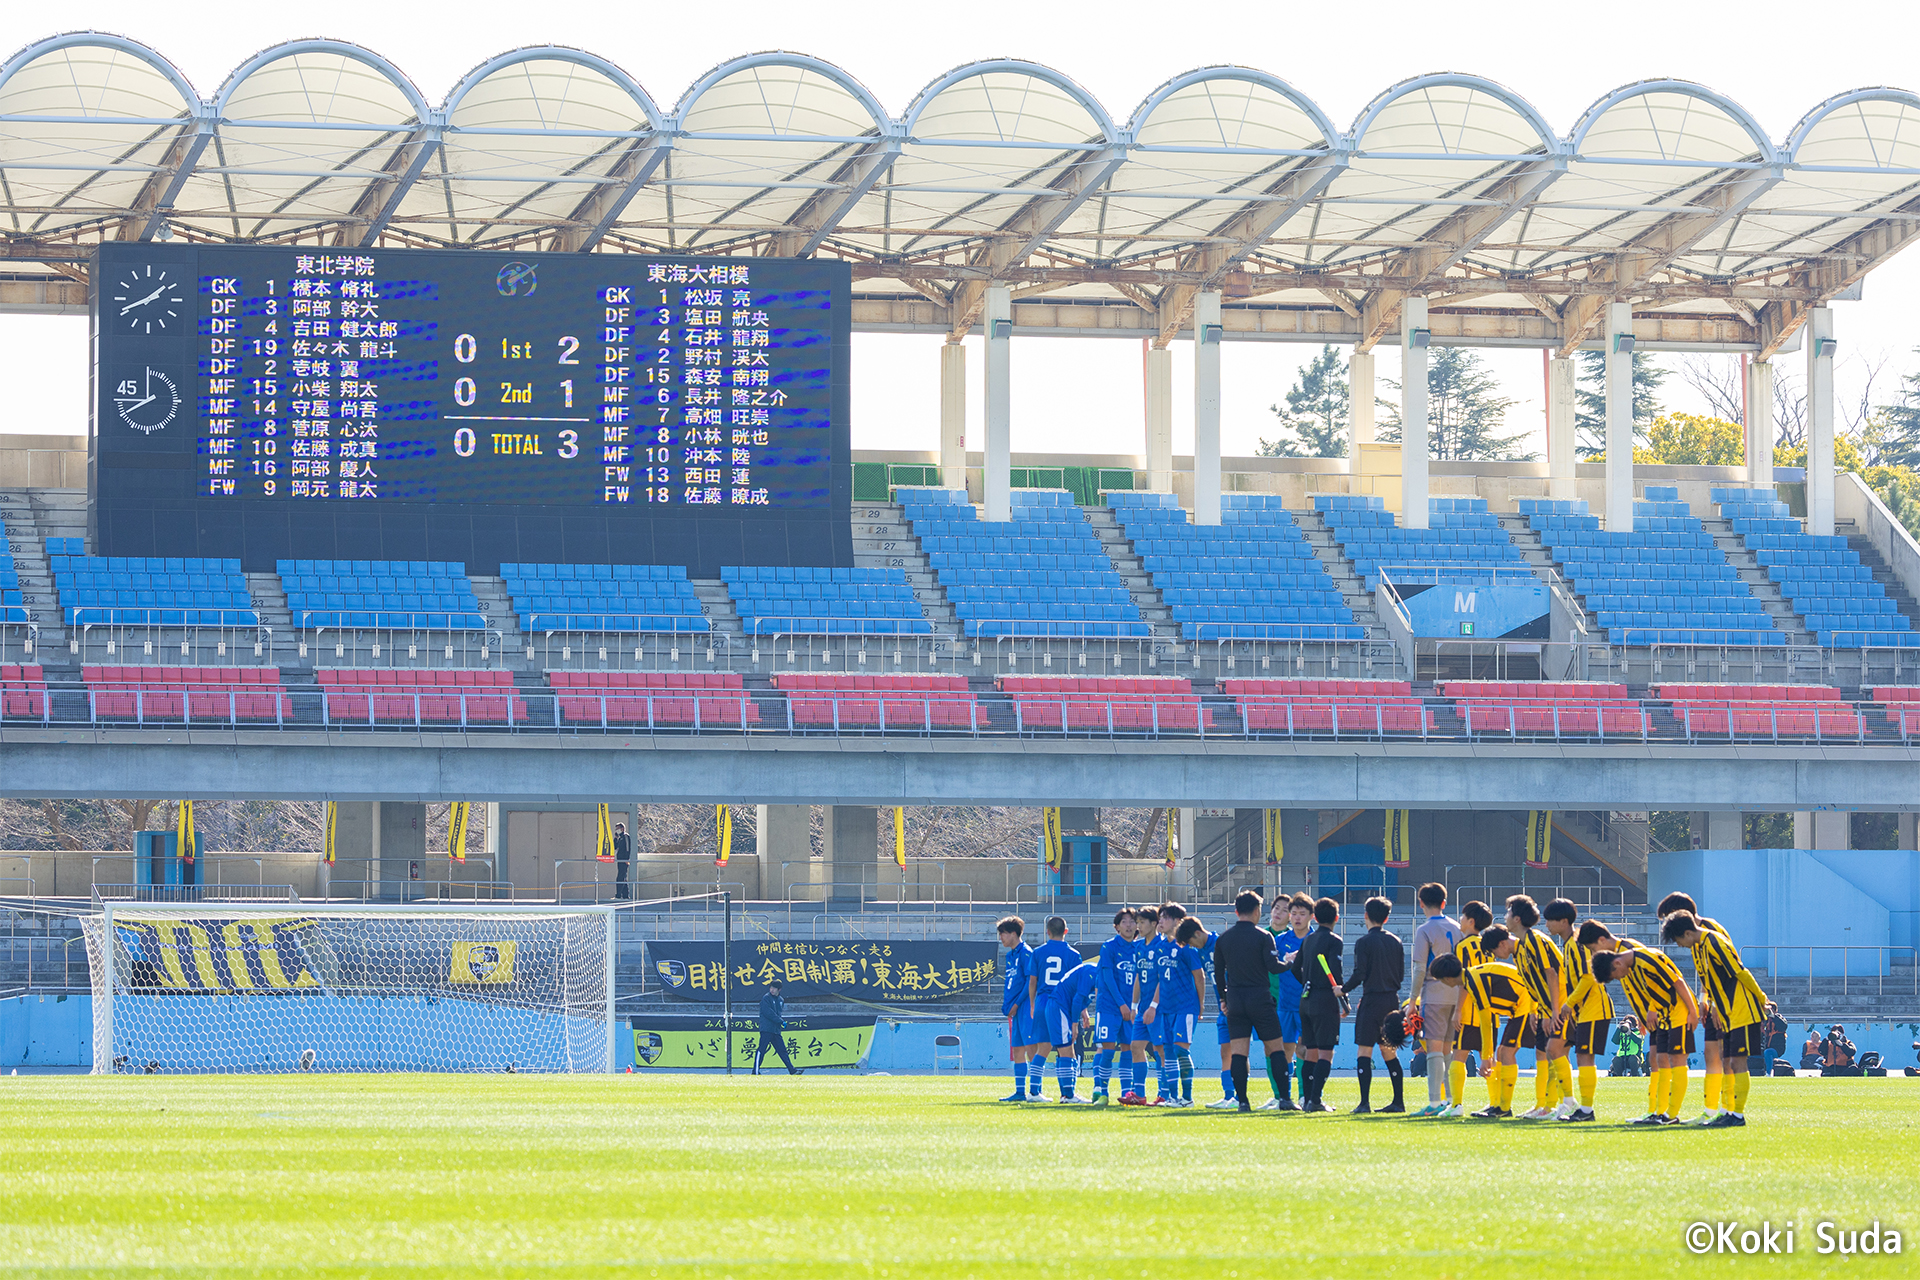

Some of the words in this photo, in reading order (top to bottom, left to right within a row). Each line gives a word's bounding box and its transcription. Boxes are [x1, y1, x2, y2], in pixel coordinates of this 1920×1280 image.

[296, 255, 374, 275] 東北学院
[648, 264, 749, 284] 東海大相模
[212, 279, 236, 294] GK
[267, 280, 273, 294] 1
[293, 279, 331, 297] 橋本
[606, 288, 630, 303] GK
[660, 289, 666, 303] 1
[685, 289, 722, 306] 松坂
[733, 290, 750, 307] 亮
[212, 299, 236, 313] DF
[266, 300, 277, 315] 3
[294, 300, 331, 317] 阿部
[341, 301, 378, 318] 幹大
[606, 308, 629, 322] DF
[659, 309, 669, 324] 3
[685, 309, 721, 325] 塩田
[732, 310, 769, 327] 航央
[212, 319, 236, 334] DF
[265, 320, 277, 334] 4
[293, 319, 329, 336] 吉田
[340, 321, 397, 338] 健太郎
[606, 327, 629, 342] DF
[658, 329, 670, 343] 4
[685, 329, 722, 345] 石井
[732, 329, 768, 346] 龍翔
[212, 339, 235, 353] DF
[253, 340, 277, 355] 19
[292, 340, 349, 357] 佐々木
[360, 341, 397, 358] 龍斗
[455, 334, 476, 363] 0
[502, 338, 531, 358] 1st
[558, 336, 579, 364] 2
[606, 347, 629, 362] DF
[658, 348, 669, 363] 2
[685, 349, 722, 365] 野村
[211, 359, 235, 374] DF
[265, 360, 276, 375] 2
[340, 361, 358, 377] 翼
[606, 367, 629, 382] DF
[647, 368, 669, 383] 15
[685, 368, 722, 385] 森安
[733, 369, 768, 386] 南翔
[117, 381, 136, 394] 45
[210, 379, 235, 394] MF
[253, 380, 276, 395] 15
[292, 380, 330, 397] 小柴
[340, 381, 377, 397] 翔太
[455, 378, 476, 406] 0
[501, 382, 531, 403] 2nd
[561, 380, 572, 407] 1
[605, 387, 629, 402] MF
[658, 388, 669, 403] 6
[685, 388, 722, 405] 長井
[732, 389, 788, 406] 隆之介
[210, 399, 235, 414] MF
[253, 400, 276, 415] 14
[292, 400, 329, 417] 守屋
[341, 401, 377, 418] 尚吾
[604, 407, 629, 422] MF
[658, 408, 669, 422] 7
[686, 407, 721, 424] 高畑
[210, 419, 235, 434] MF
[265, 420, 276, 435] 8
[292, 420, 330, 437] 菅原
[604, 427, 628, 441] MF
[658, 428, 669, 443] 8
[685, 428, 722, 444] 小林
[210, 439, 235, 454] MF
[253, 440, 276, 455] 10
[291, 440, 329, 457] 佐藤
[340, 441, 377, 457] 成真
[454, 428, 475, 456] 0
[491, 434, 543, 454] TOTAL
[558, 430, 578, 458] 3
[604, 446, 628, 461] MF
[646, 448, 669, 462] 10
[685, 448, 722, 464] 沖本
[732, 448, 750, 464] 陸
[210, 459, 234, 474] MF
[253, 460, 276, 475] 16
[292, 460, 330, 477] 阿部
[340, 461, 377, 477] 慶人
[605, 466, 629, 481] FW
[647, 467, 669, 482] 13
[686, 468, 720, 483] 西田
[732, 468, 749, 484] 蓮
[211, 479, 234, 494] FW
[265, 480, 275, 495] 9
[292, 481, 329, 497] 岡元
[340, 480, 377, 498] 龍太
[605, 486, 629, 501] FW
[646, 487, 668, 502] 18
[685, 487, 721, 504] 佐藤
[868, 510, 880, 518] 29
[892, 559, 904, 567] 26
[22, 596, 35, 604] 23
[478, 602, 489, 610] 23
[1454, 592, 1476, 613] M
[1045, 956, 1062, 985] 2
[1125, 972, 1133, 985] 19
[1141, 970, 1148, 983] 9
[1164, 968, 1171, 981] 4
[1098, 1026, 1109, 1039] 19
